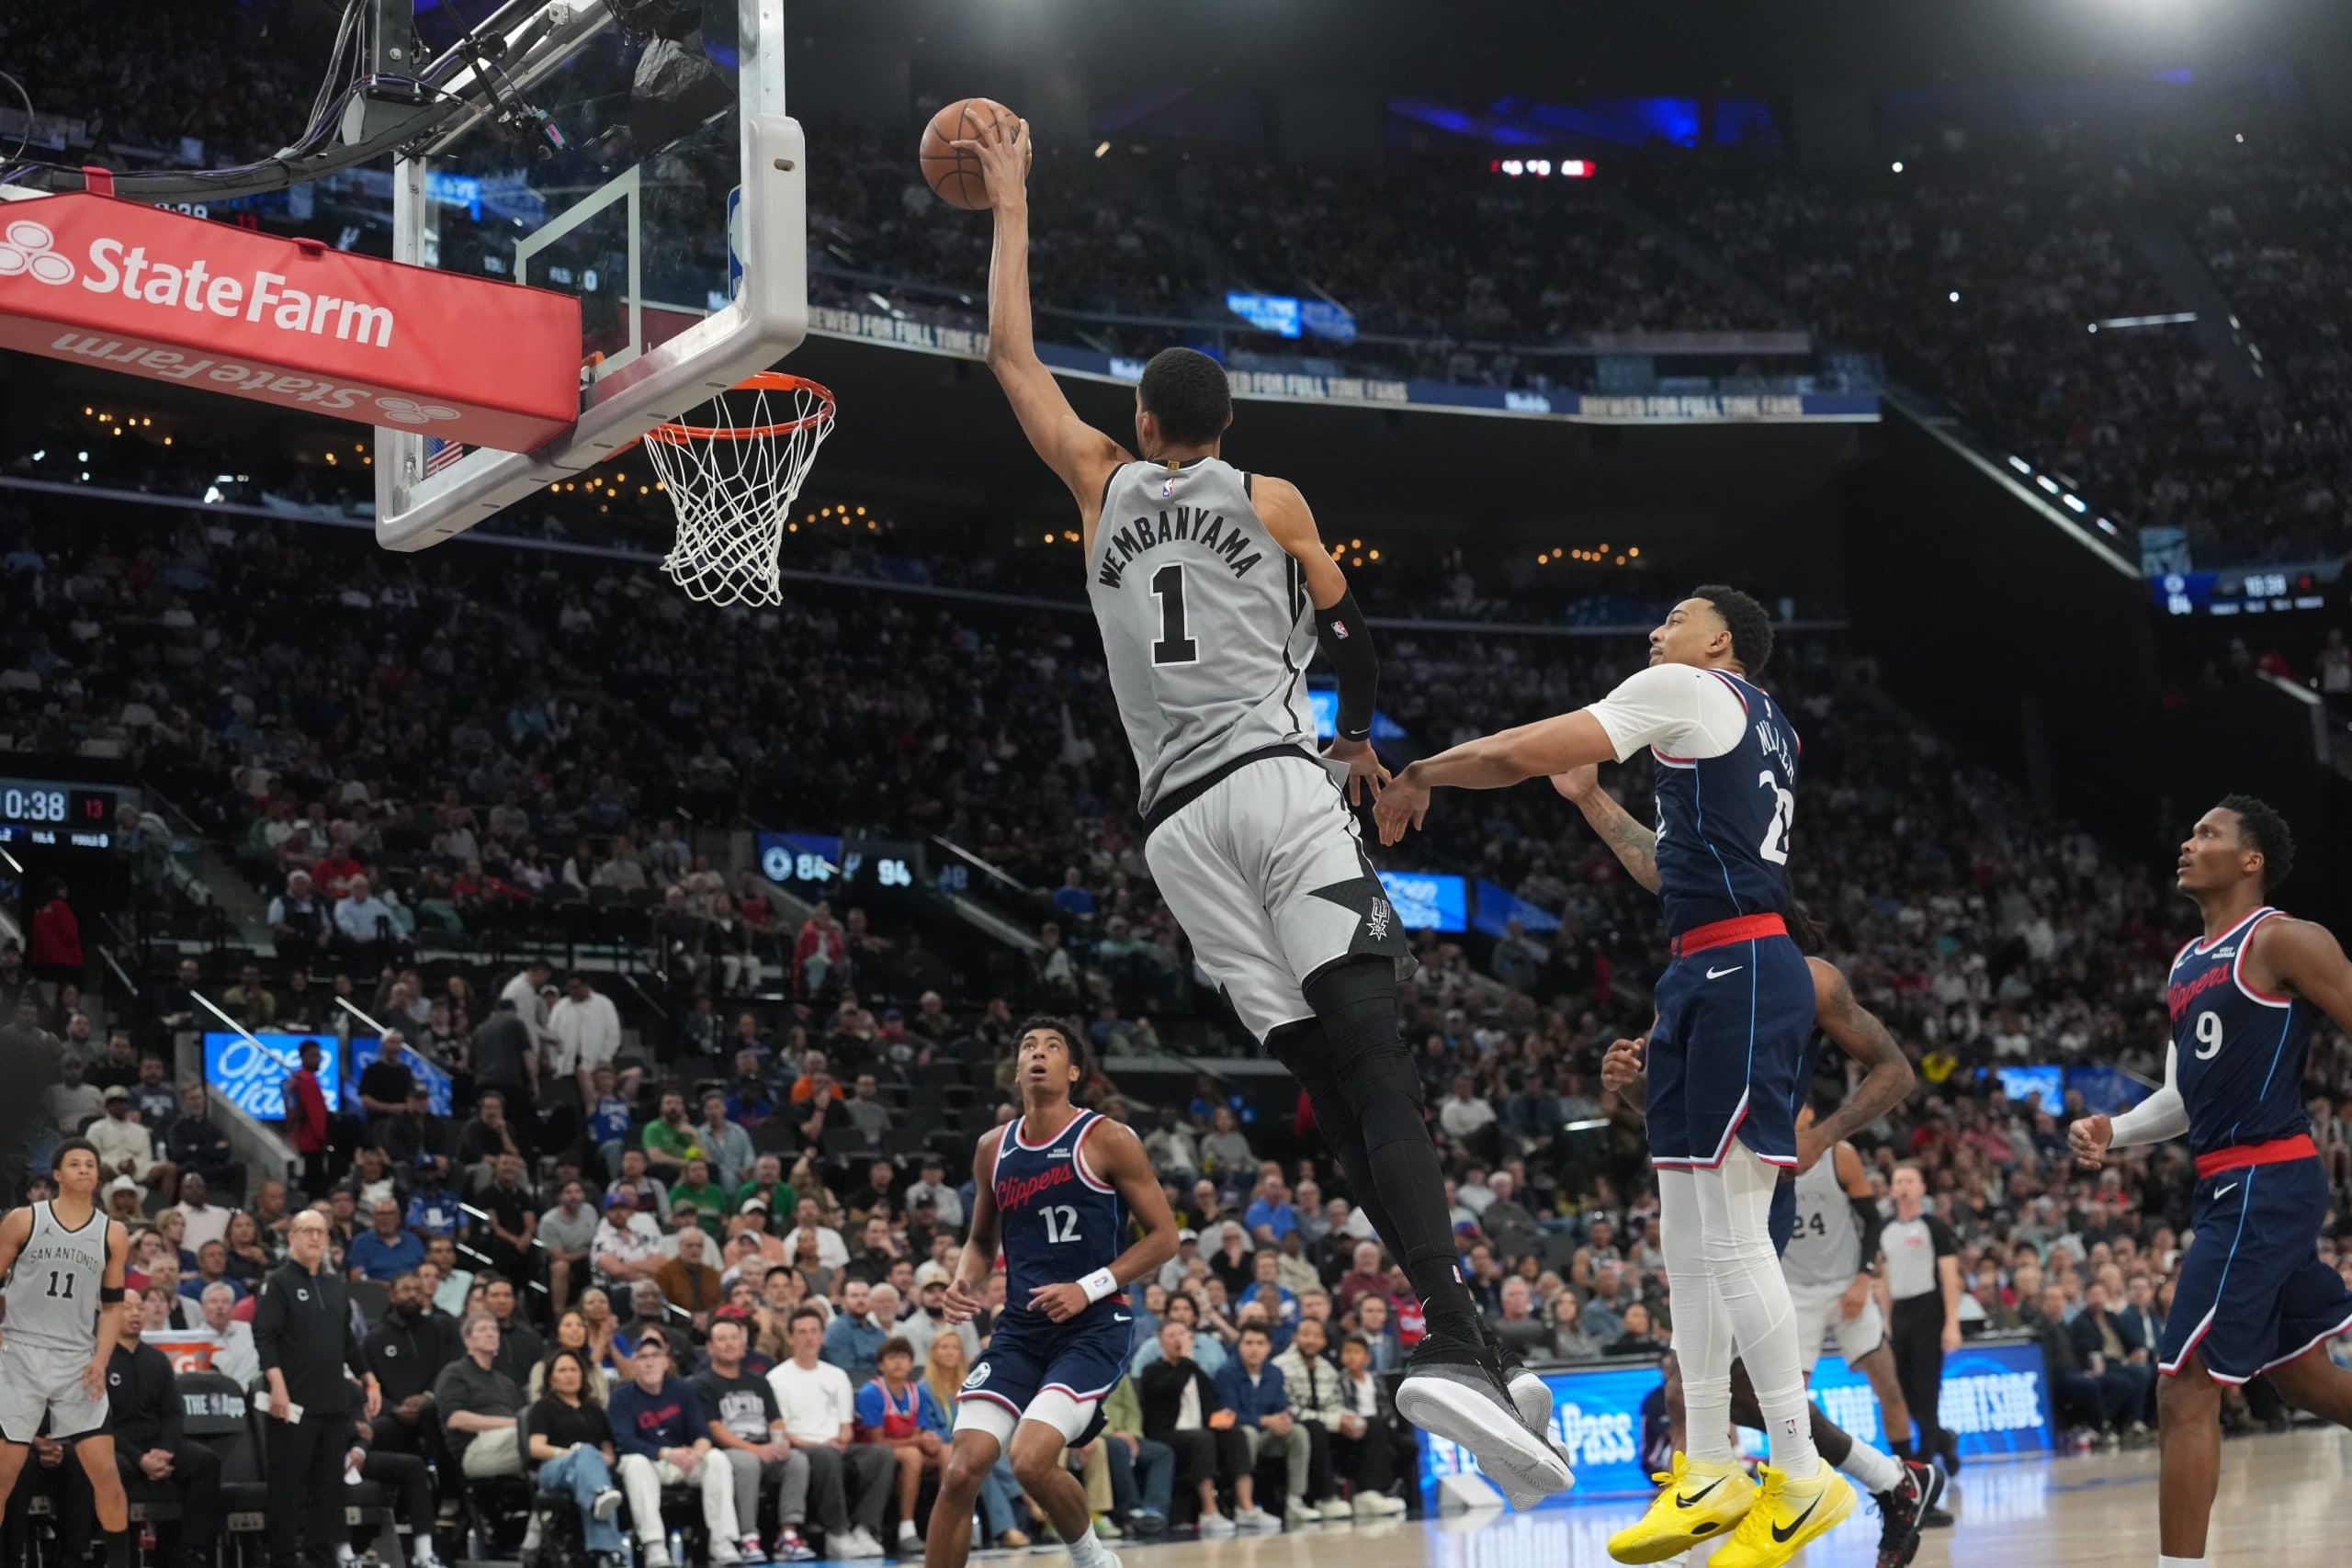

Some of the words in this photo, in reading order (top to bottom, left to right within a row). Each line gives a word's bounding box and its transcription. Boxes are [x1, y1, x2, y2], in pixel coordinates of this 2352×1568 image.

[1099, 507, 1262, 590] WEMBANYAMA
[1150, 561, 1199, 668] 1
[5, 789, 65, 822] 0:38
[2195, 1010, 2223, 1060] 9
[996, 1161, 1073, 1212] Clippers
[1037, 1205, 1081, 1244] 12
[1792, 1213, 1826, 1239] 24
[30, 1247, 51, 1265] SAN
[55, 1245, 99, 1274] ANTONIO
[46, 1270, 75, 1299] 11
[1562, 1403, 1636, 1467] Pass
